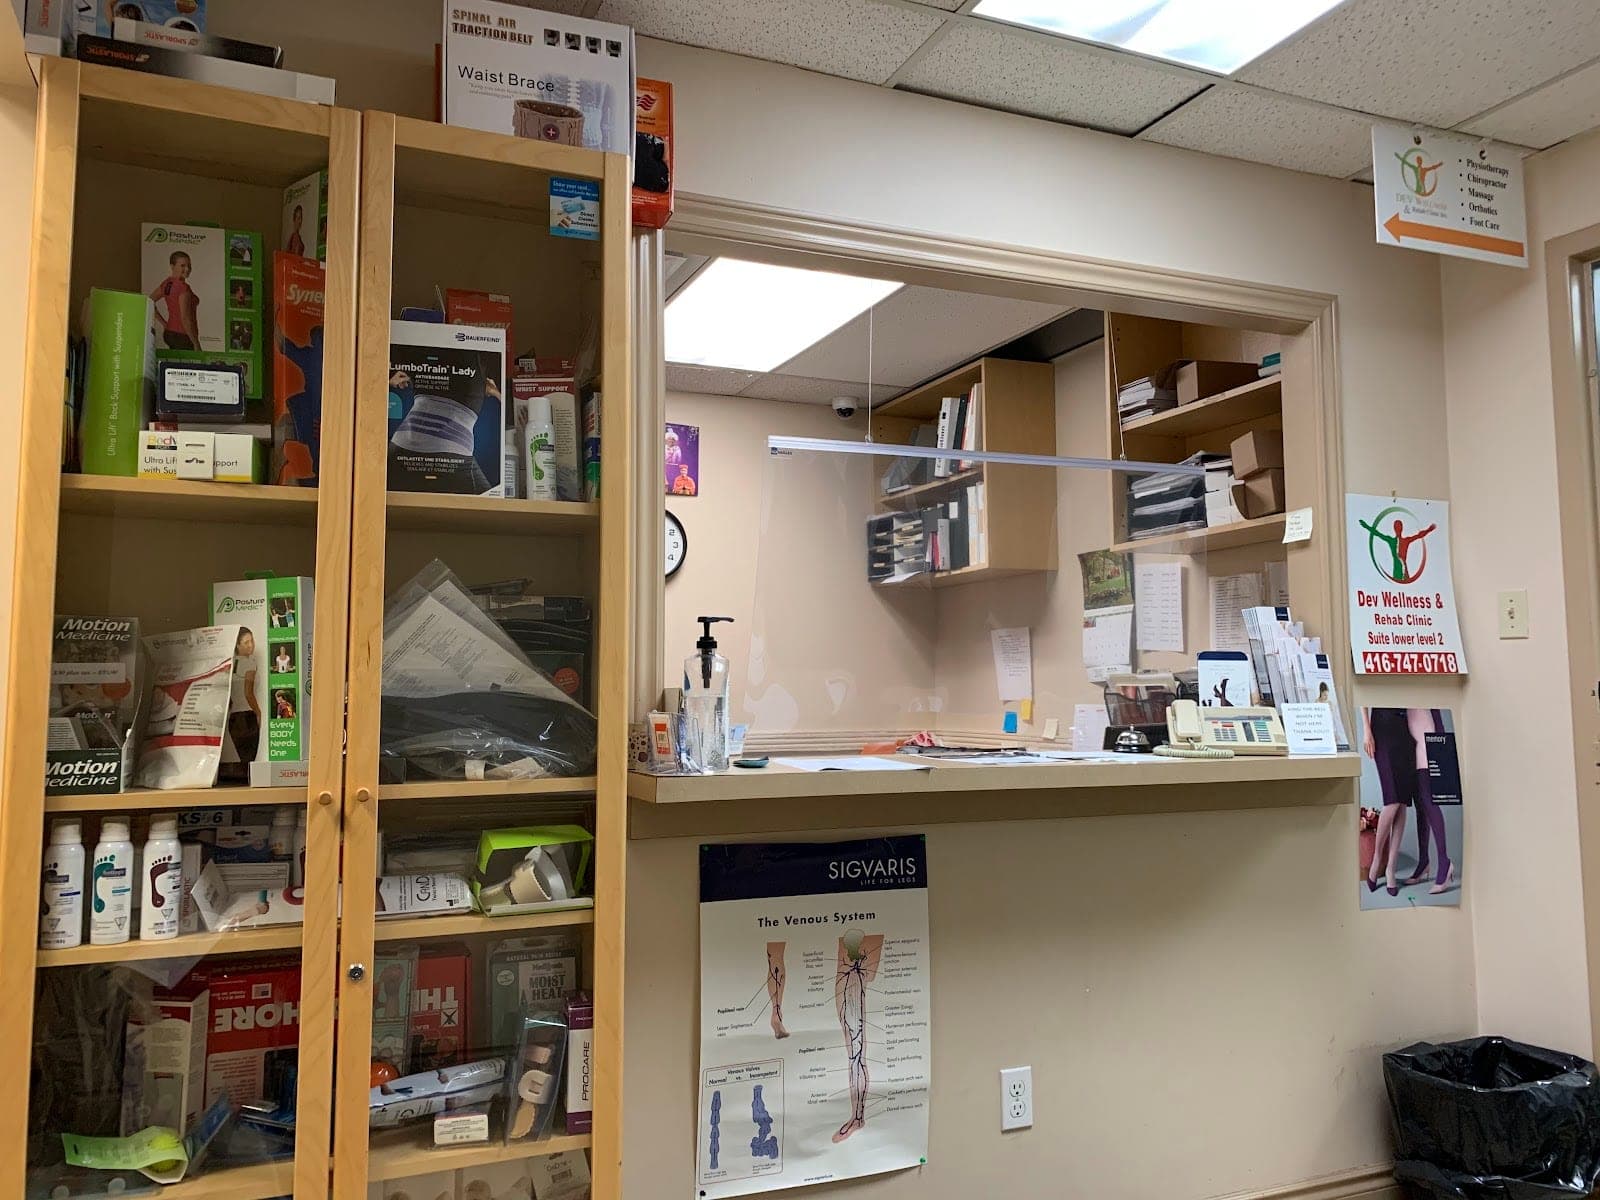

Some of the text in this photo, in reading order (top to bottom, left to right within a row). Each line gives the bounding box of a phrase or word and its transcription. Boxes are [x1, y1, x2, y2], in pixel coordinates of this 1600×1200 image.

[452, 9, 516, 28] SPINAL AIR
[453, 22, 534, 45] TRACTION BELT
[458, 65, 504, 86] Waist
[508, 73, 555, 92] Brace
[1466, 159, 1509, 176] Physiotherapy
[1467, 173, 1507, 189] Chiropractor
[1468, 187, 1494, 201] Massage
[1469, 202, 1498, 216] Orthotics
[1469, 216, 1500, 231] Foot Care
[452, 366, 476, 378] Lady
[144, 456, 164, 464] Ultra
[144, 466, 160, 474] with
[235, 598, 265, 608] Posture
[1357, 590, 1444, 609] Dev Wellness &
[62, 618, 130, 632] Motion
[1374, 613, 1433, 626] Rehab Clinic
[55, 631, 131, 642] Medicine
[1368, 631, 1444, 646] Suite lower level 2
[1365, 653, 1457, 673] 416-747-0718
[270, 749, 288, 757] One
[828, 857, 916, 880] SIGVARIS
[861, 876, 916, 886] LIFE FOR LEGS
[757, 911, 876, 928] The Venous System
[529, 974, 566, 989] MOIST
[532, 987, 562, 1001] HEAT
[582, 1041, 590, 1101] PROCARE
